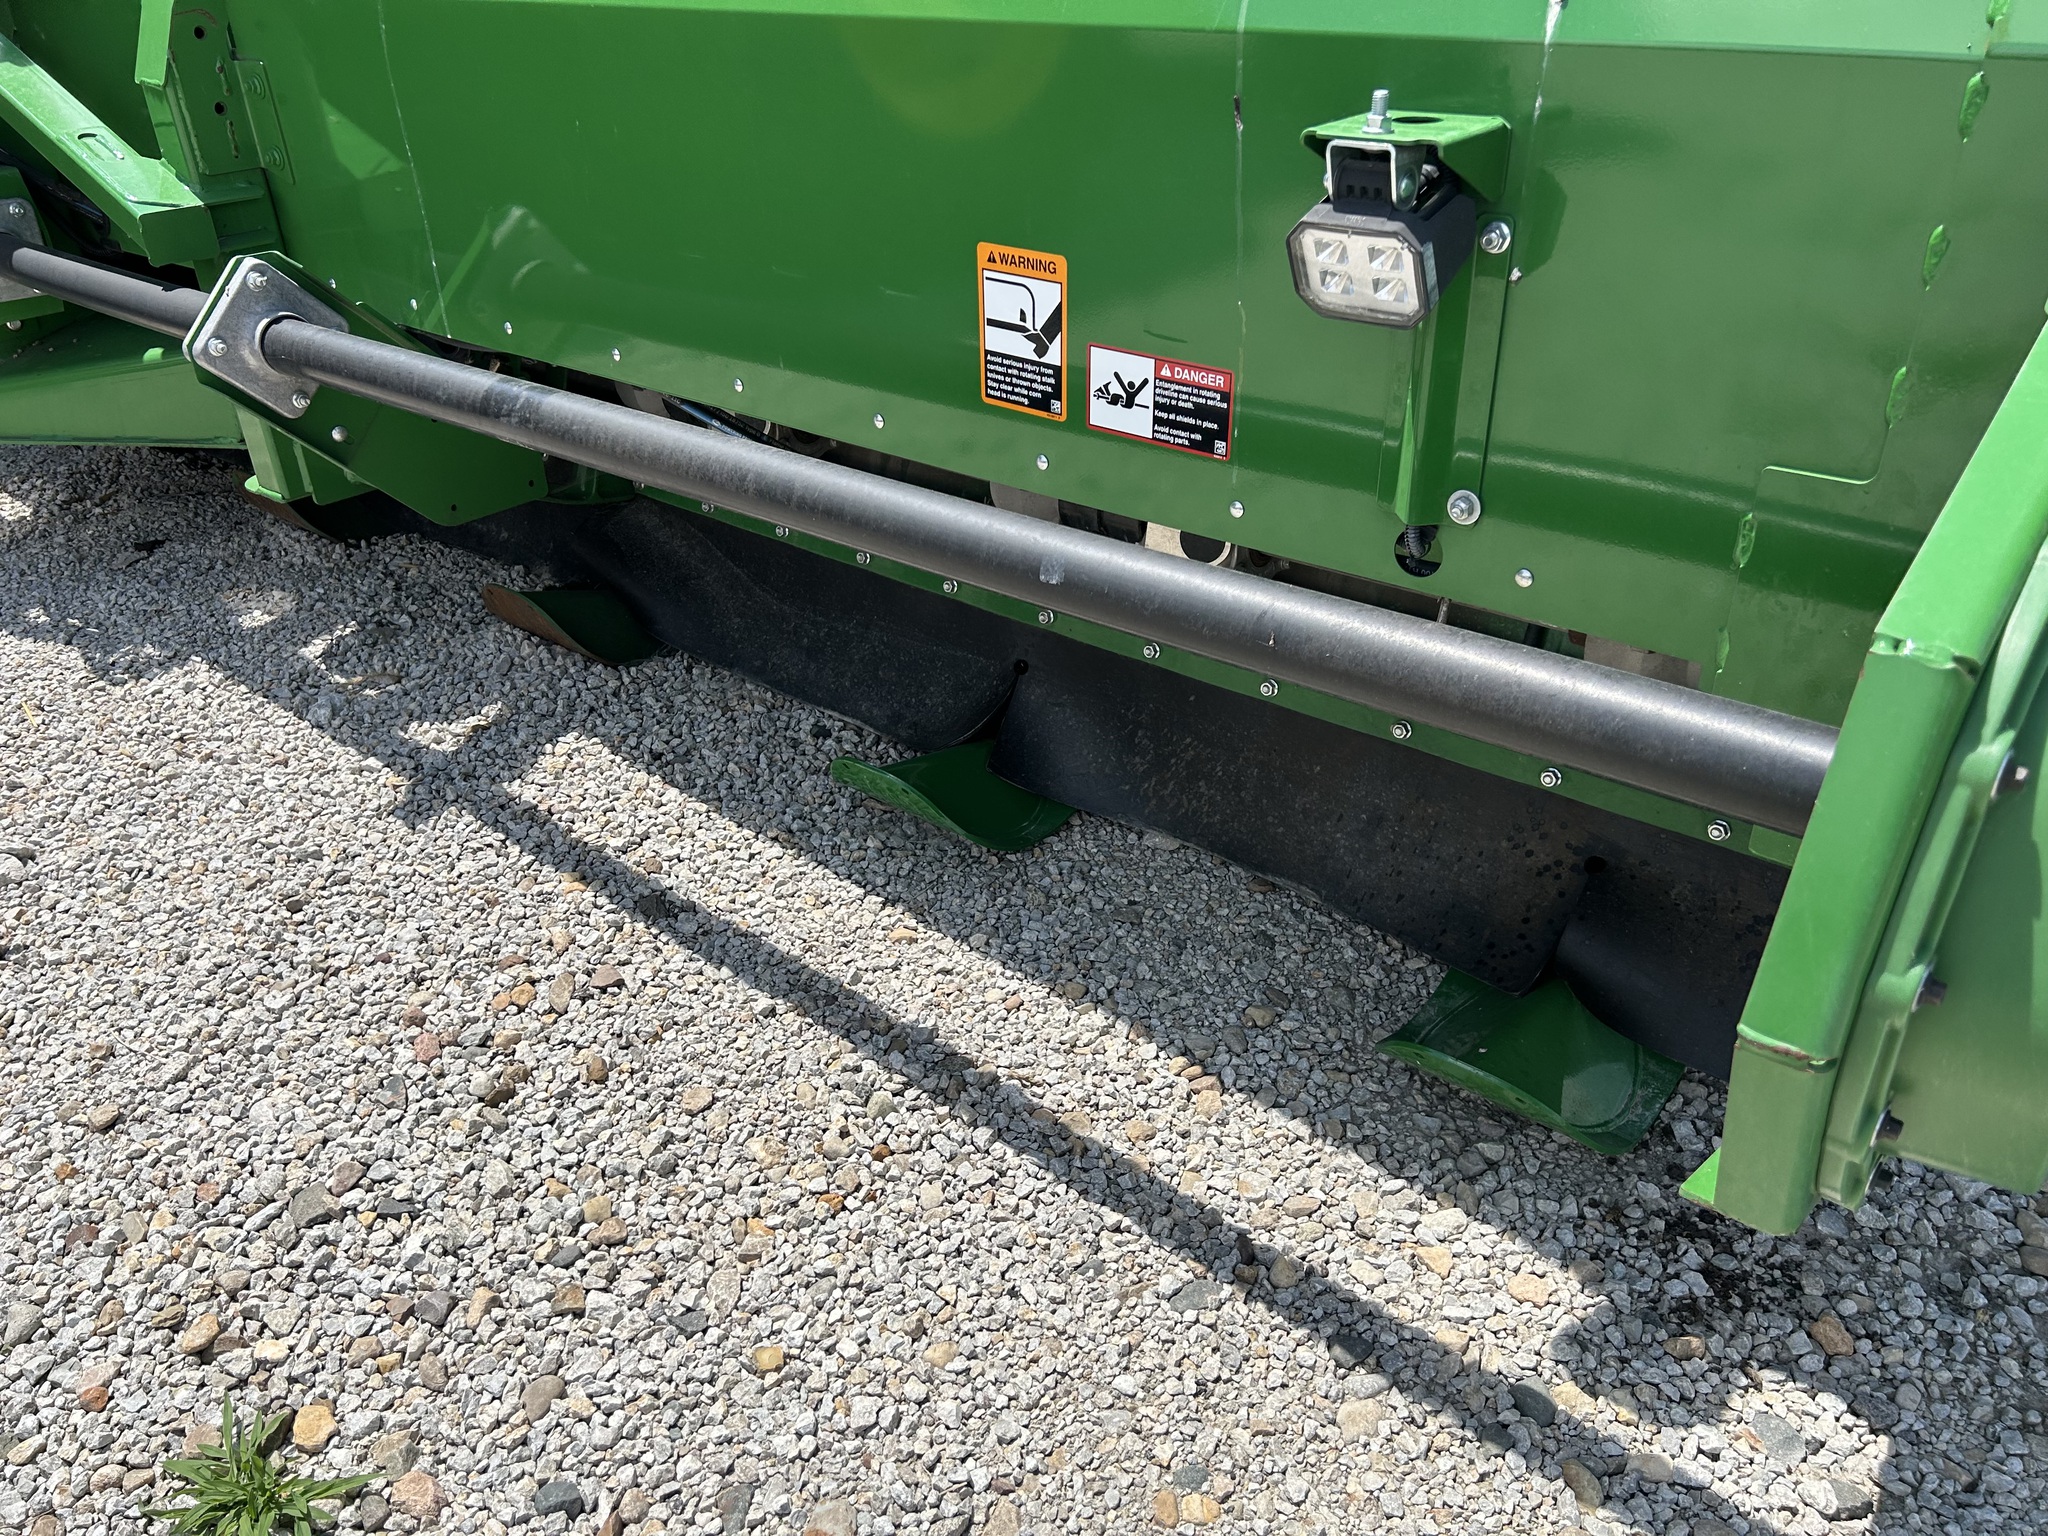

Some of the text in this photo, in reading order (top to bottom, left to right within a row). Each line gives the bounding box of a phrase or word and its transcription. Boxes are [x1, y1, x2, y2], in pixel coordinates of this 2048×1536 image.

[998, 252, 1056, 274] WARNING
[987, 354, 1053, 375] Avoid serious injury from
[987, 364, 1006, 373] contact
[1020, 371, 1040, 382] rotating
[1042, 376, 1055, 384] stalk
[987, 371, 1004, 381] knives
[1012, 377, 1030, 387] thrown
[1032, 382, 1053, 392] objects.
[988, 379, 999, 389] Stay
[1014, 387, 1028, 395] while
[1174, 367, 1224, 388] DANGER
[988, 388, 1000, 396] head
[1007, 394, 1029, 405] running.
[1155, 388, 1178, 398] driveline
[1190, 396, 1206, 404] cause
[1207, 399, 1227, 409] serious
[1156, 380, 1192, 393] Entanglement
[1199, 389, 1220, 400] rotating
[1155, 395, 1170, 405] injury
[1178, 400, 1194, 409] death.
[1155, 409, 1168, 419] Keep
[1176, 415, 1195, 425] shields
[1203, 420, 1219, 430] place.
[1154, 424, 1169, 433] Avoid
[1170, 428, 1189, 438] contact
[1154, 432, 1190, 446] rotating parts.
